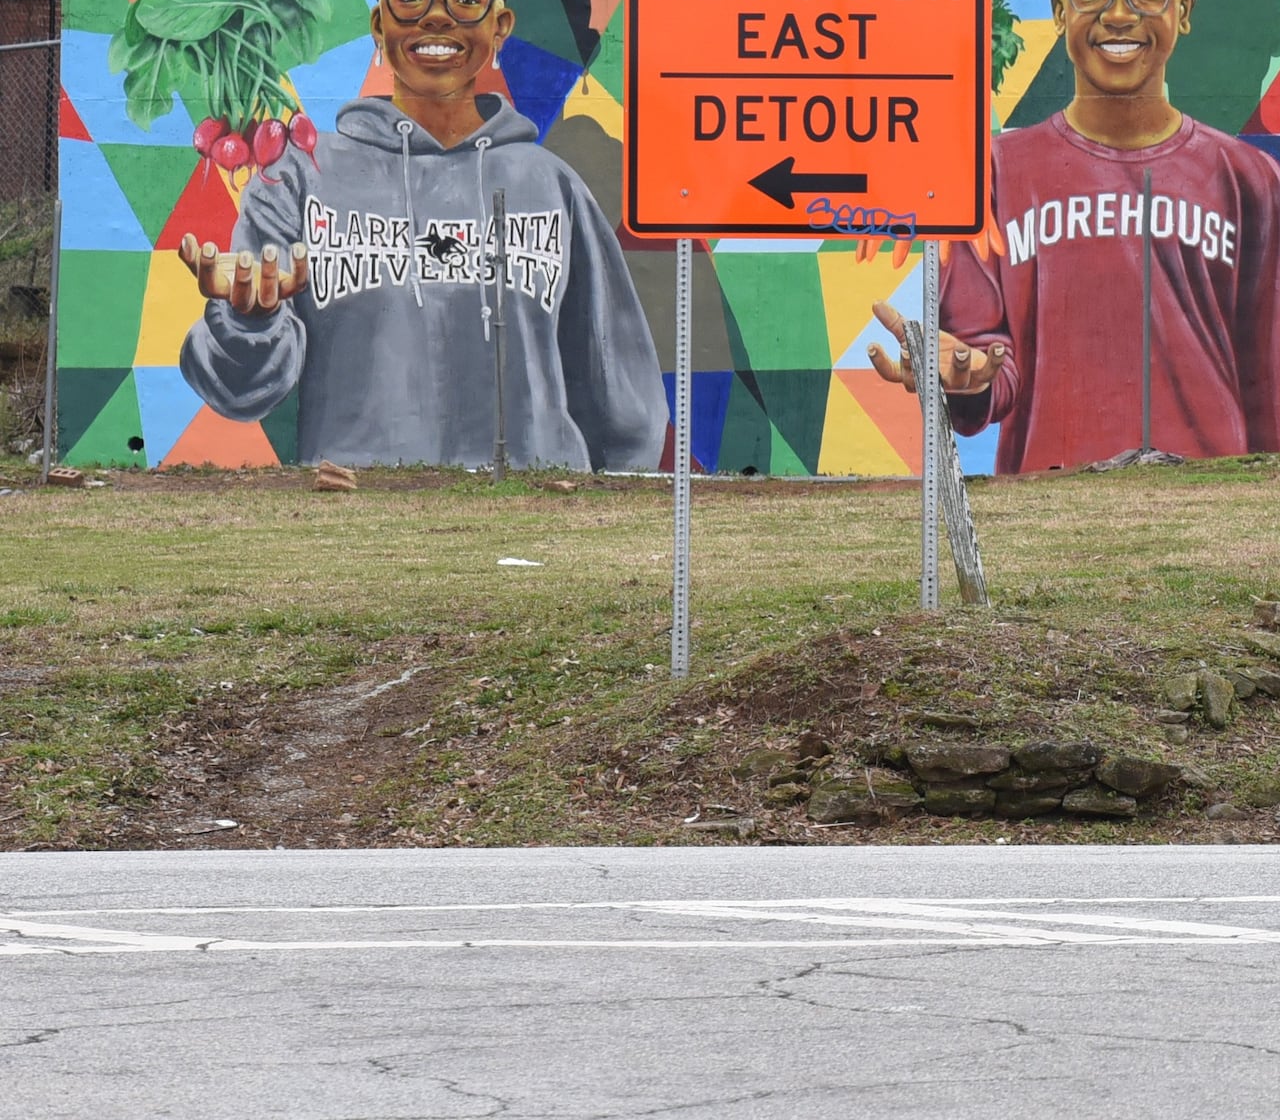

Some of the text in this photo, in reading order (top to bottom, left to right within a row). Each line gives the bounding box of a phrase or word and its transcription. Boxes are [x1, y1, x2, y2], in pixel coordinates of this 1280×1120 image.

[737, 12, 878, 60] EAST
[693, 94, 920, 144] DETOUR
[304, 196, 564, 256] CLARK ATLANTA
[1005, 192, 1237, 268] MOREHOUSE
[308, 251, 563, 310] UNIVERSITY
